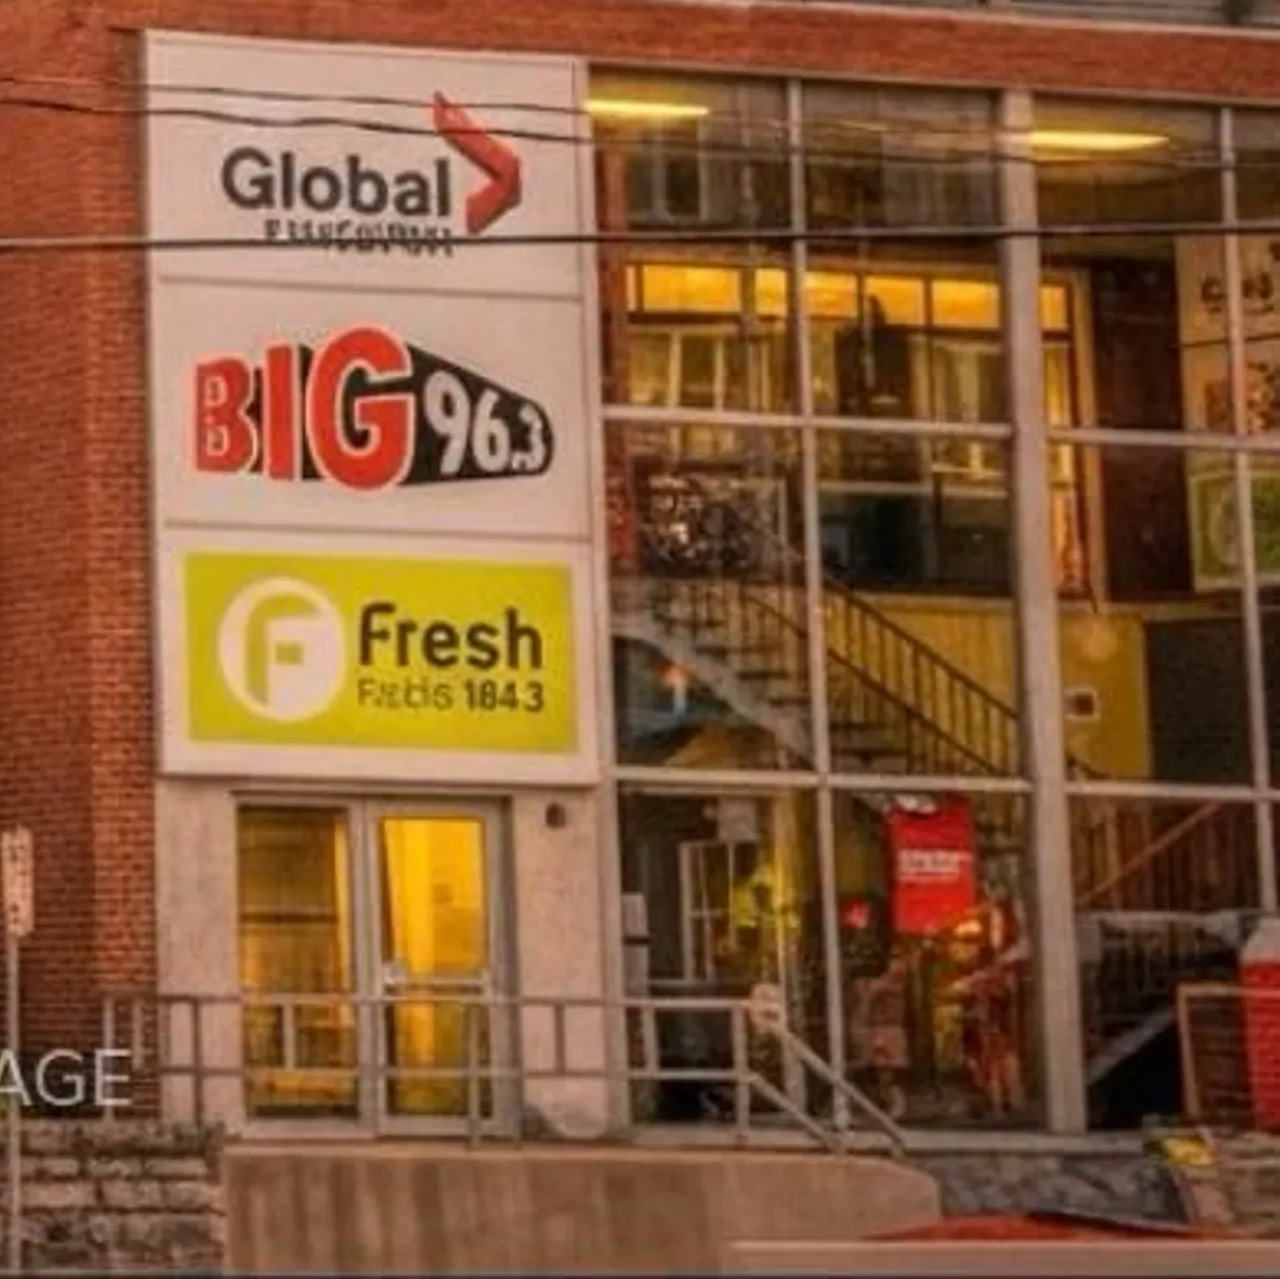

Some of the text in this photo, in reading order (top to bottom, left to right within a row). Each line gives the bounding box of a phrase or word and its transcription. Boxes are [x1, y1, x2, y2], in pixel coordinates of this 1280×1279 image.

[220, 146, 452, 217] Global
[195, 326, 414, 491] BIG
[358, 602, 542, 669] Fresh
